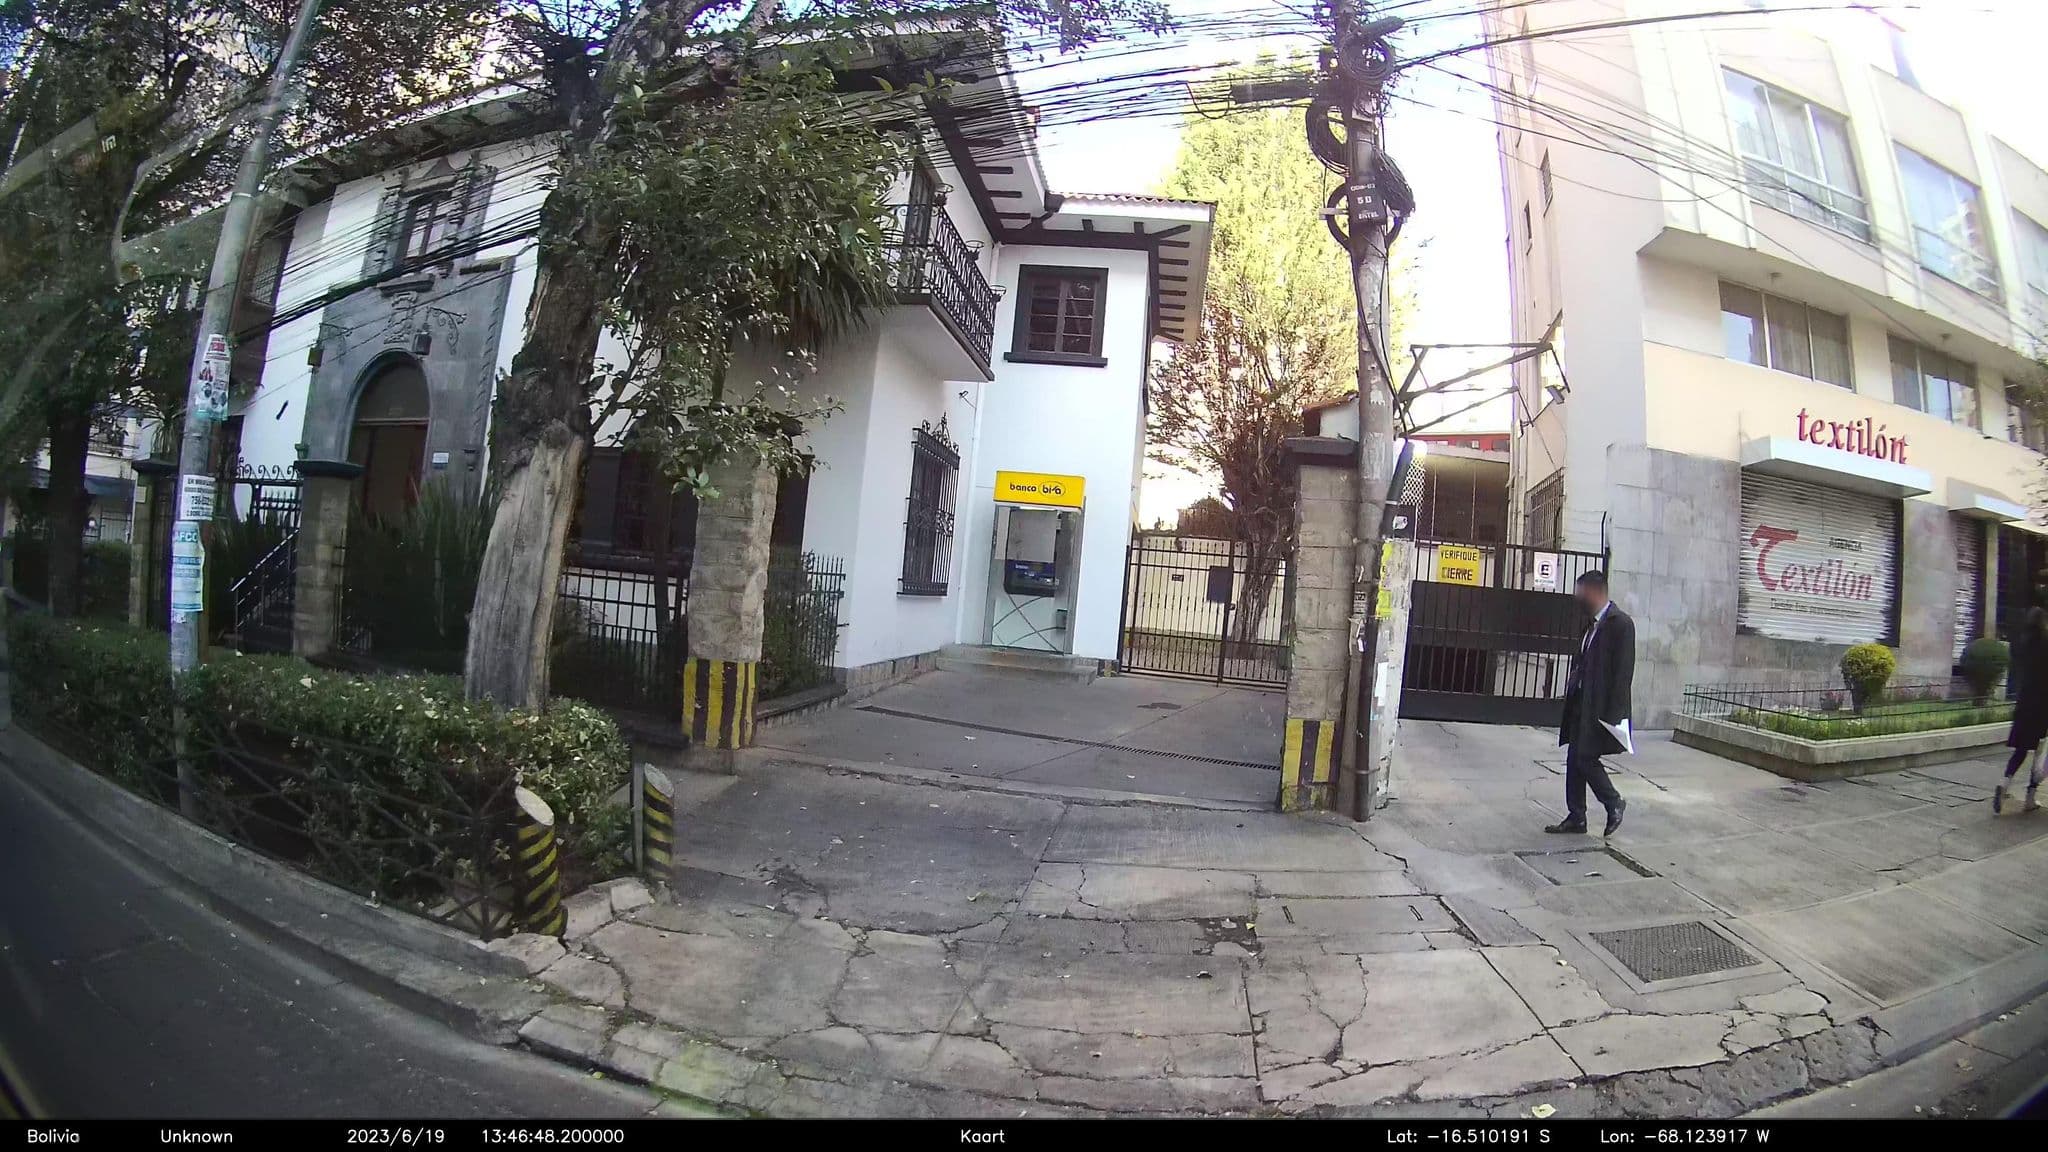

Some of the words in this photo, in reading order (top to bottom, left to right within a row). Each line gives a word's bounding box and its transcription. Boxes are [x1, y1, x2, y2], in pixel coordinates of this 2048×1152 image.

[1010, 482, 1037, 492] banco
[1441, 549, 1477, 561] VERIFIQUE
[1750, 524, 1873, 600] Textilón
[1441, 567, 1473, 580] CIERRE
[1541, 564, 1550, 576] E
